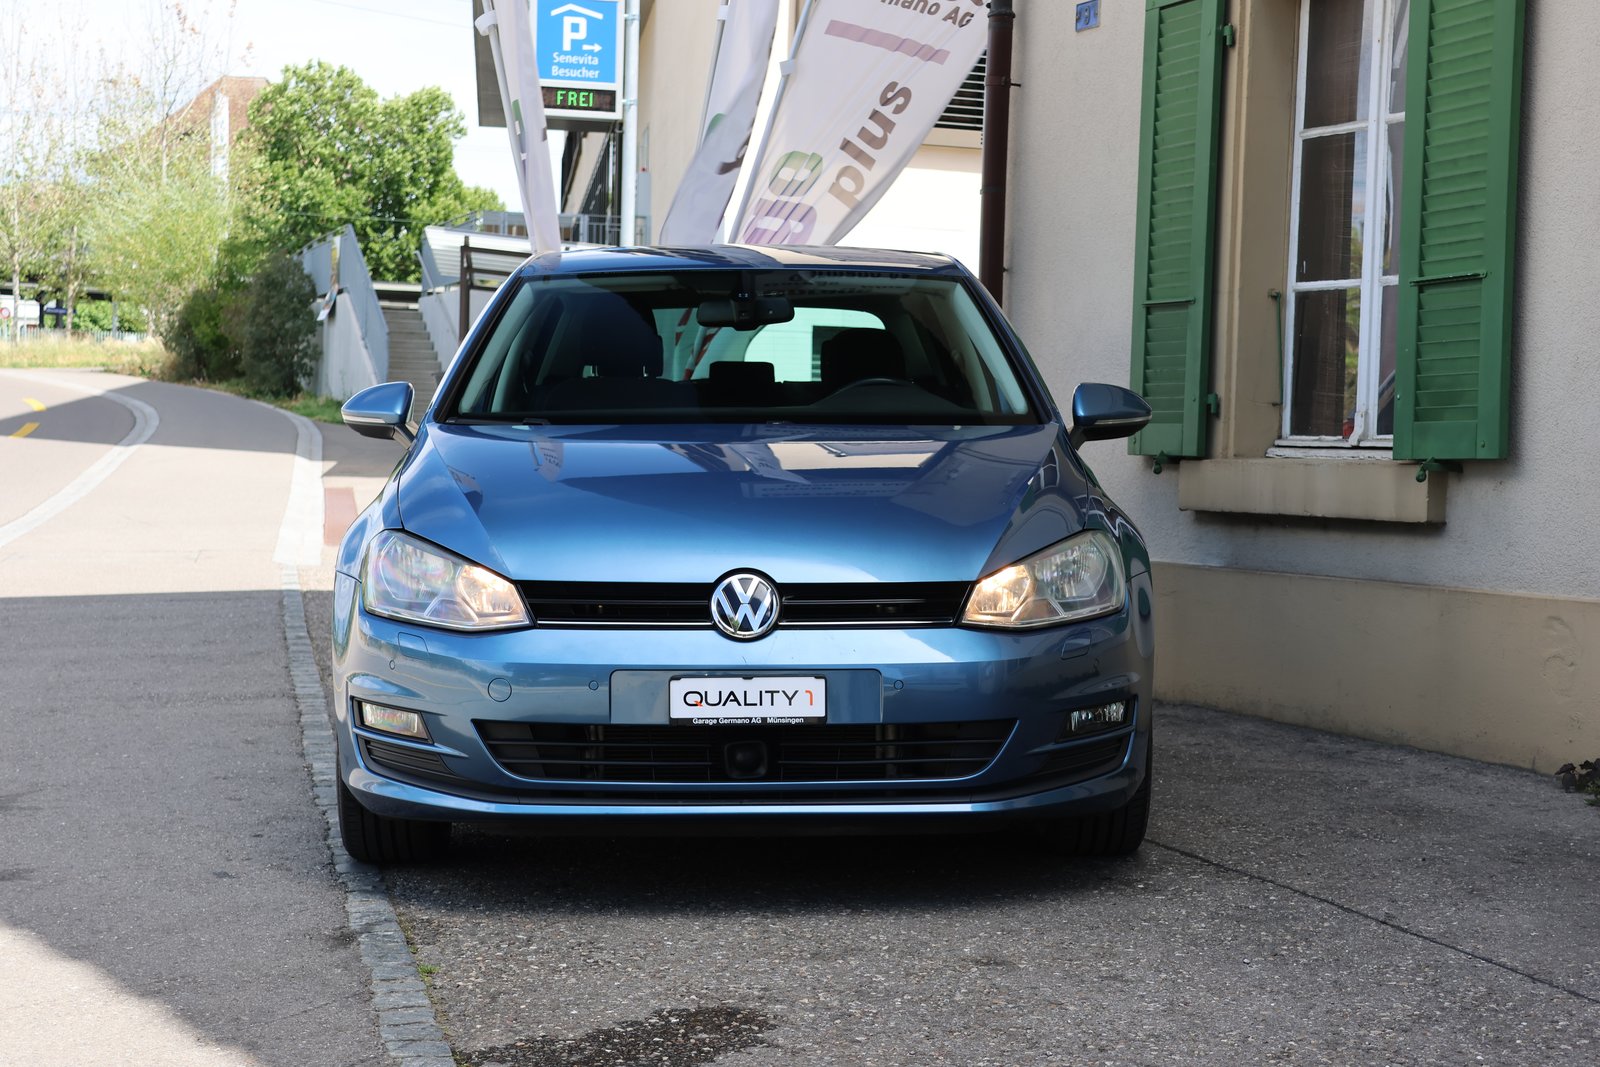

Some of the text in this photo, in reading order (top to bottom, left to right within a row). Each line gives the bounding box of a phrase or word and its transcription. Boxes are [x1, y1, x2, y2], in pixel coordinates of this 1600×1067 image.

[942, 6, 975, 28] AG
[562, 16, 587, 51] P
[552, 52, 599, 65] Senevita
[551, 65, 600, 79] Besucher
[556, 90, 594, 107] FREI
[827, 81, 912, 209] plus
[713, 575, 777, 636] VW
[692, 717, 718, 725] Garage
[767, 717, 804, 725] Münsingen
